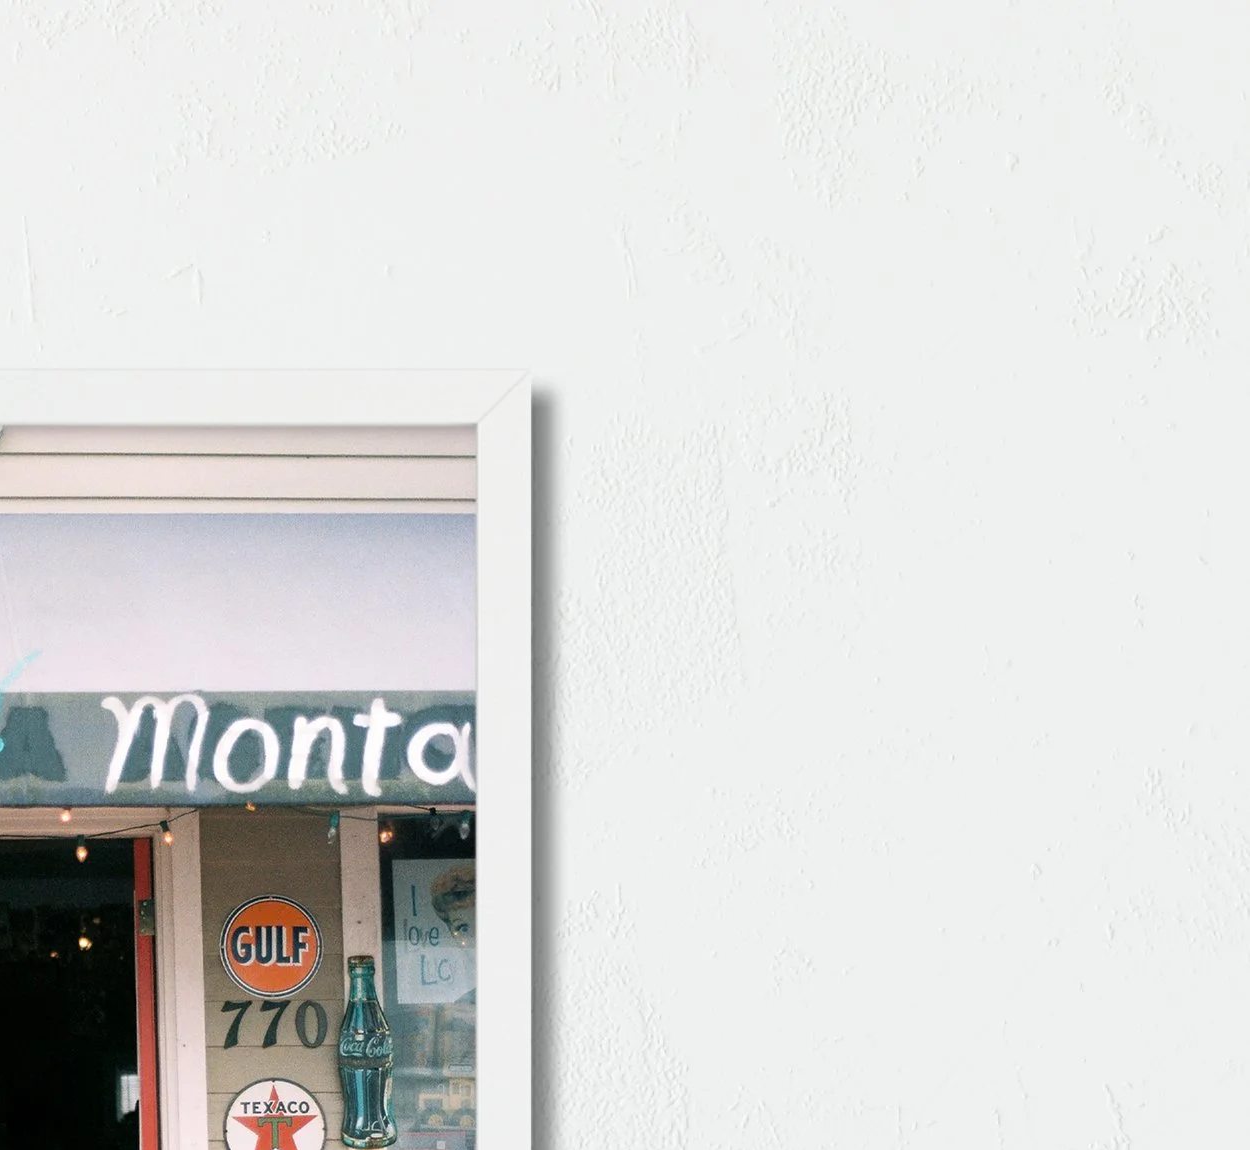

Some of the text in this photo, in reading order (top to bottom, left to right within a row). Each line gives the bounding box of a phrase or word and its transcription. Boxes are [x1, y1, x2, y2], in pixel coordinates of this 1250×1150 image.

[231, 925, 309, 966] GULF
[220, 999, 329, 1049] 770
[240, 1101, 310, 1115] TEXACO
[257, 1116, 293, 1150] T
